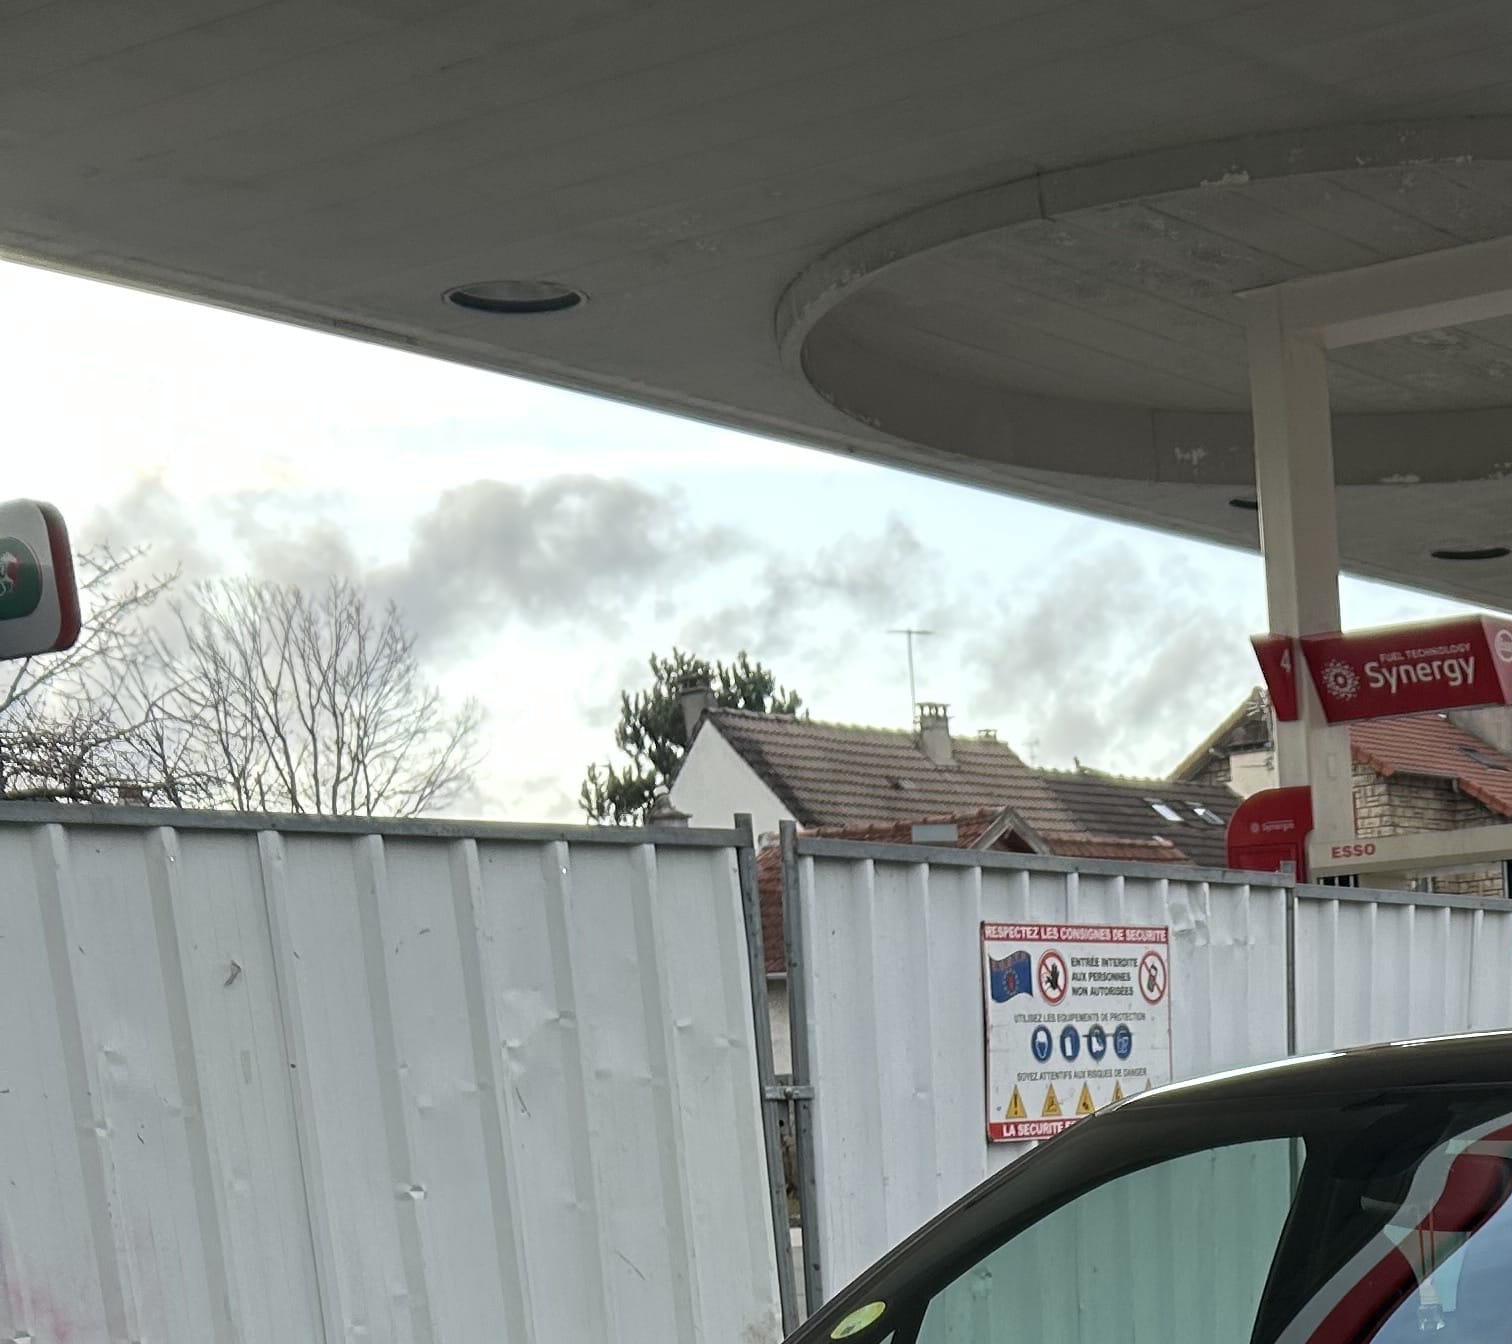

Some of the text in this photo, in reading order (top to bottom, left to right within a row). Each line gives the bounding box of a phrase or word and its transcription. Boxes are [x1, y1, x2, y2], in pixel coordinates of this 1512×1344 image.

[1279, 648, 1291, 673] 4
[1364, 655, 1475, 694] Synergy
[1331, 843, 1377, 859] ESSO
[984, 926, 1038, 939] RESPECTEZ
[1040, 927, 1058, 939] LES
[1061, 928, 1111, 940] CONSIGNES
[1112, 929, 1123, 940] DE
[1072, 972, 1131, 981] AUX PERSONNES
[1072, 986, 1088, 996] NON
[1002, 1124, 1015, 1137] LA
[1018, 1122, 1064, 1136] SECURITE
